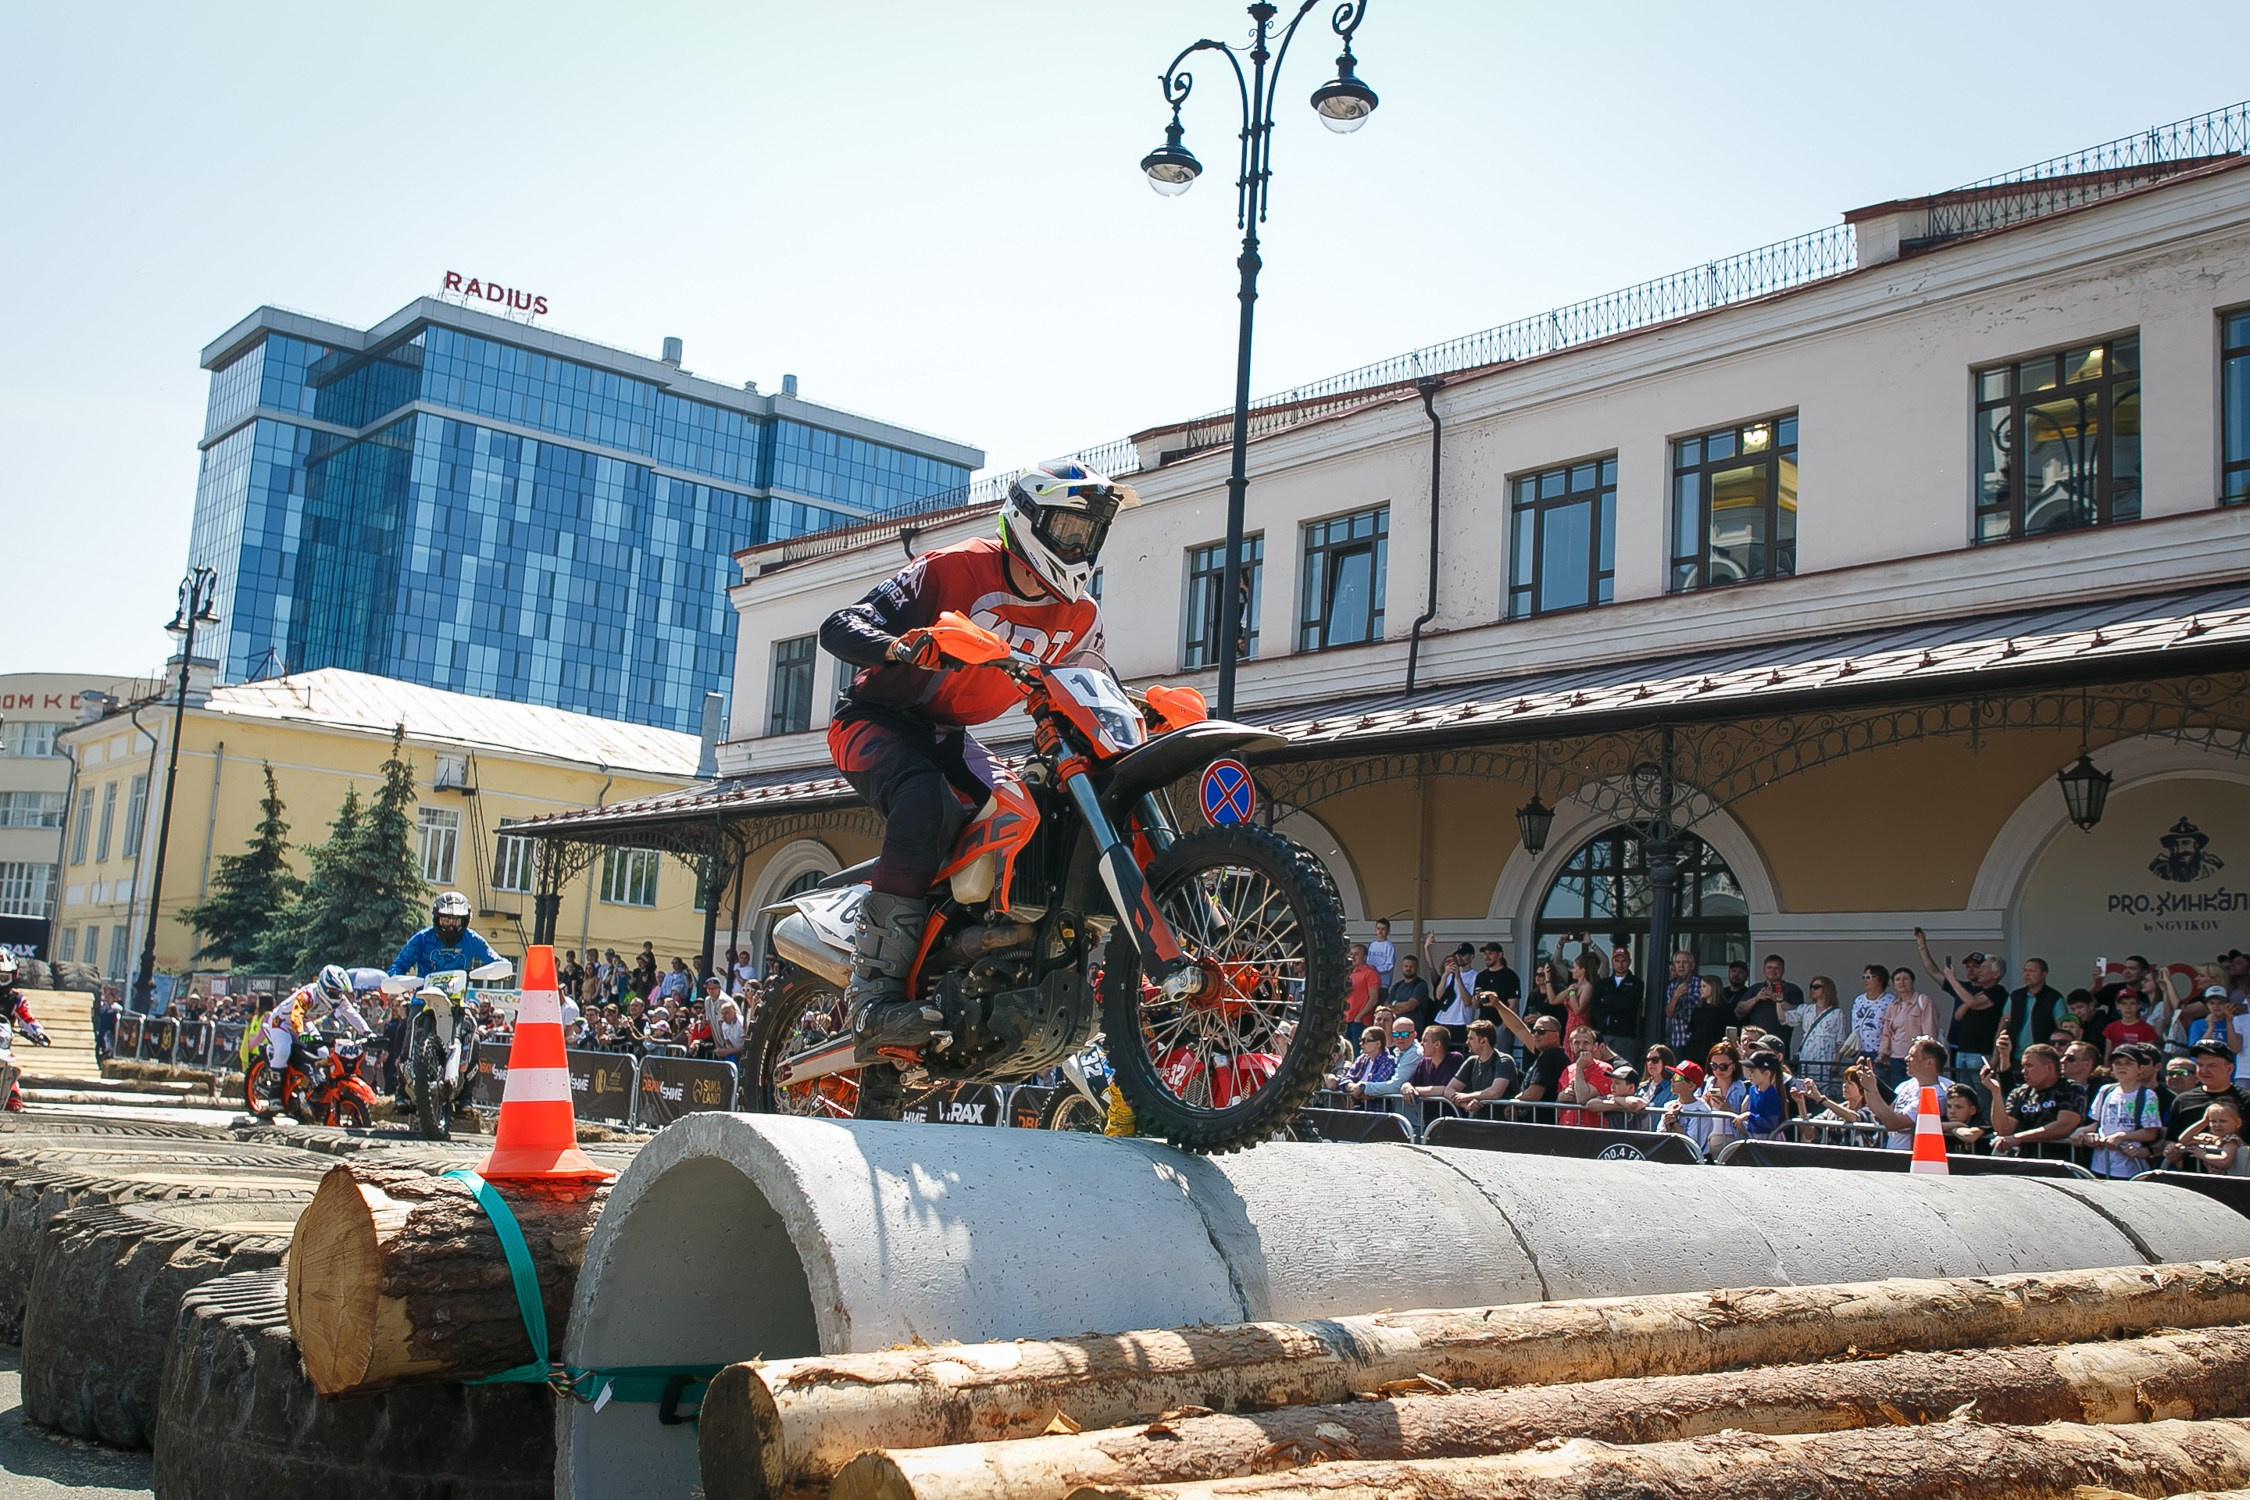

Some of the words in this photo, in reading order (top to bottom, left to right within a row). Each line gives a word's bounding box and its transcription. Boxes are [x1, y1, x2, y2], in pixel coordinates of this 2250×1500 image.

[445, 270, 548, 315] RADIUS
[0, 694, 34, 709] ОМ
[1069, 674, 1128, 706] 16
[2107, 886, 2250, 917] PRO.ХИНКАЛ
[1080, 1050, 1103, 1079] 32
[1169, 1063, 1187, 1087] 32
[702, 1091, 721, 1104] LAND
[1601, 1147, 1626, 1160] 00.4
